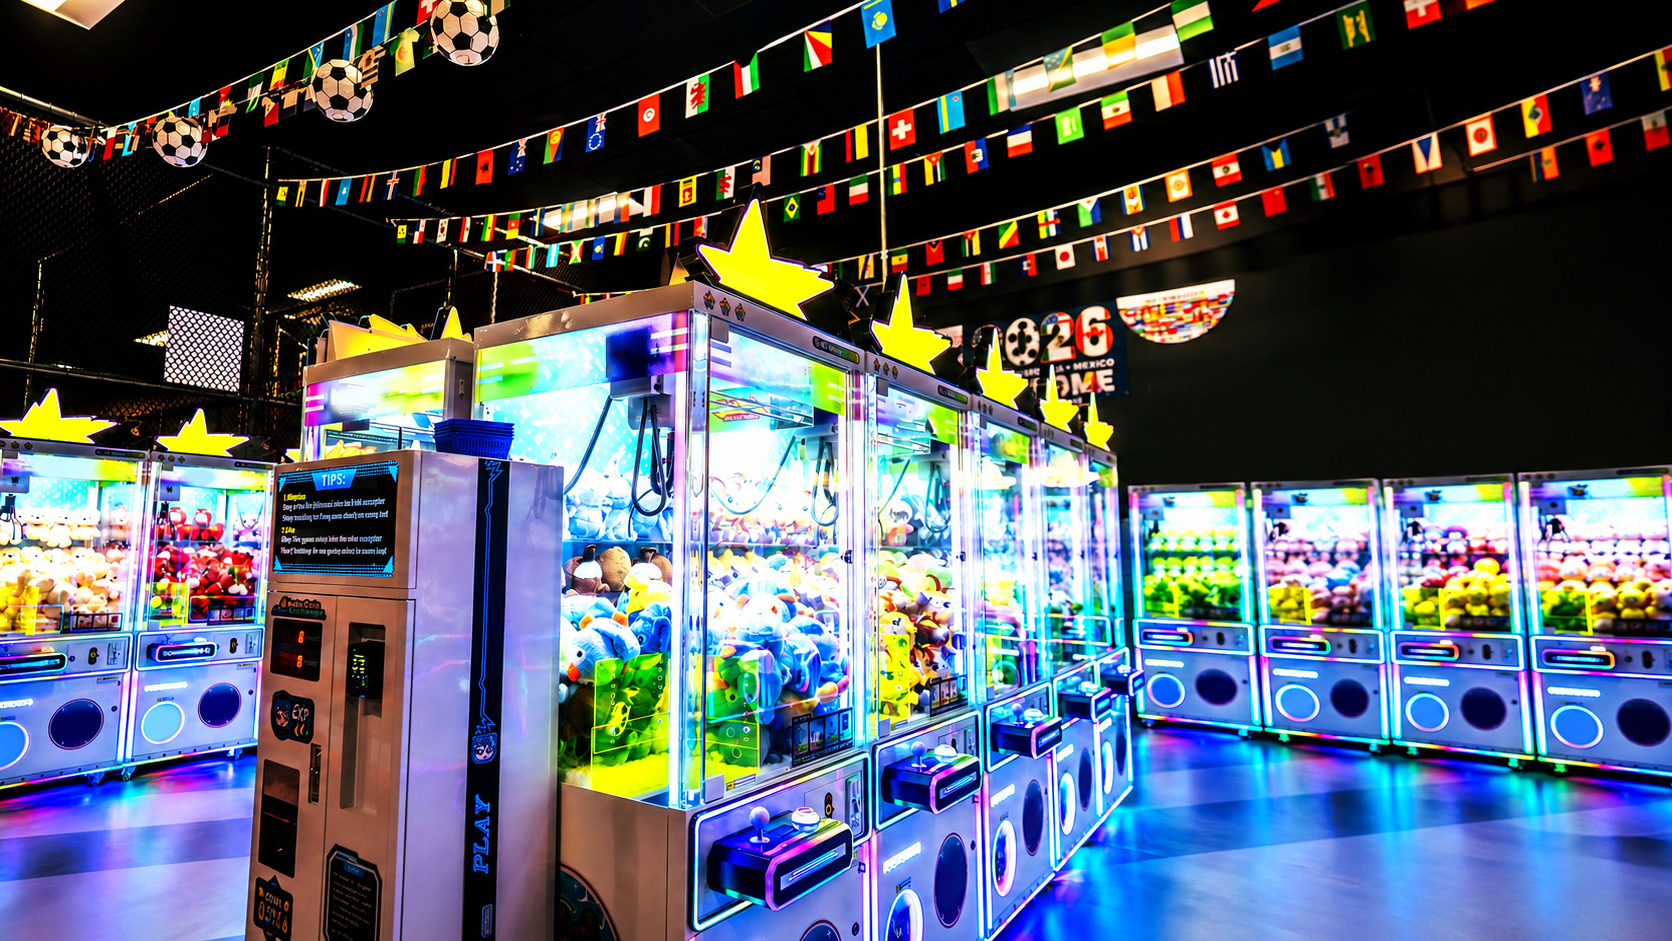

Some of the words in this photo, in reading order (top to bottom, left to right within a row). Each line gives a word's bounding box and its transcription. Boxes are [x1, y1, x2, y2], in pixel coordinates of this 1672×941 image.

[1073, 358, 1115, 371] MEXICO
[321, 473, 346, 487] TIPS:
[291, 703, 310, 722] EXP
[472, 793, 491, 875] PLAY
